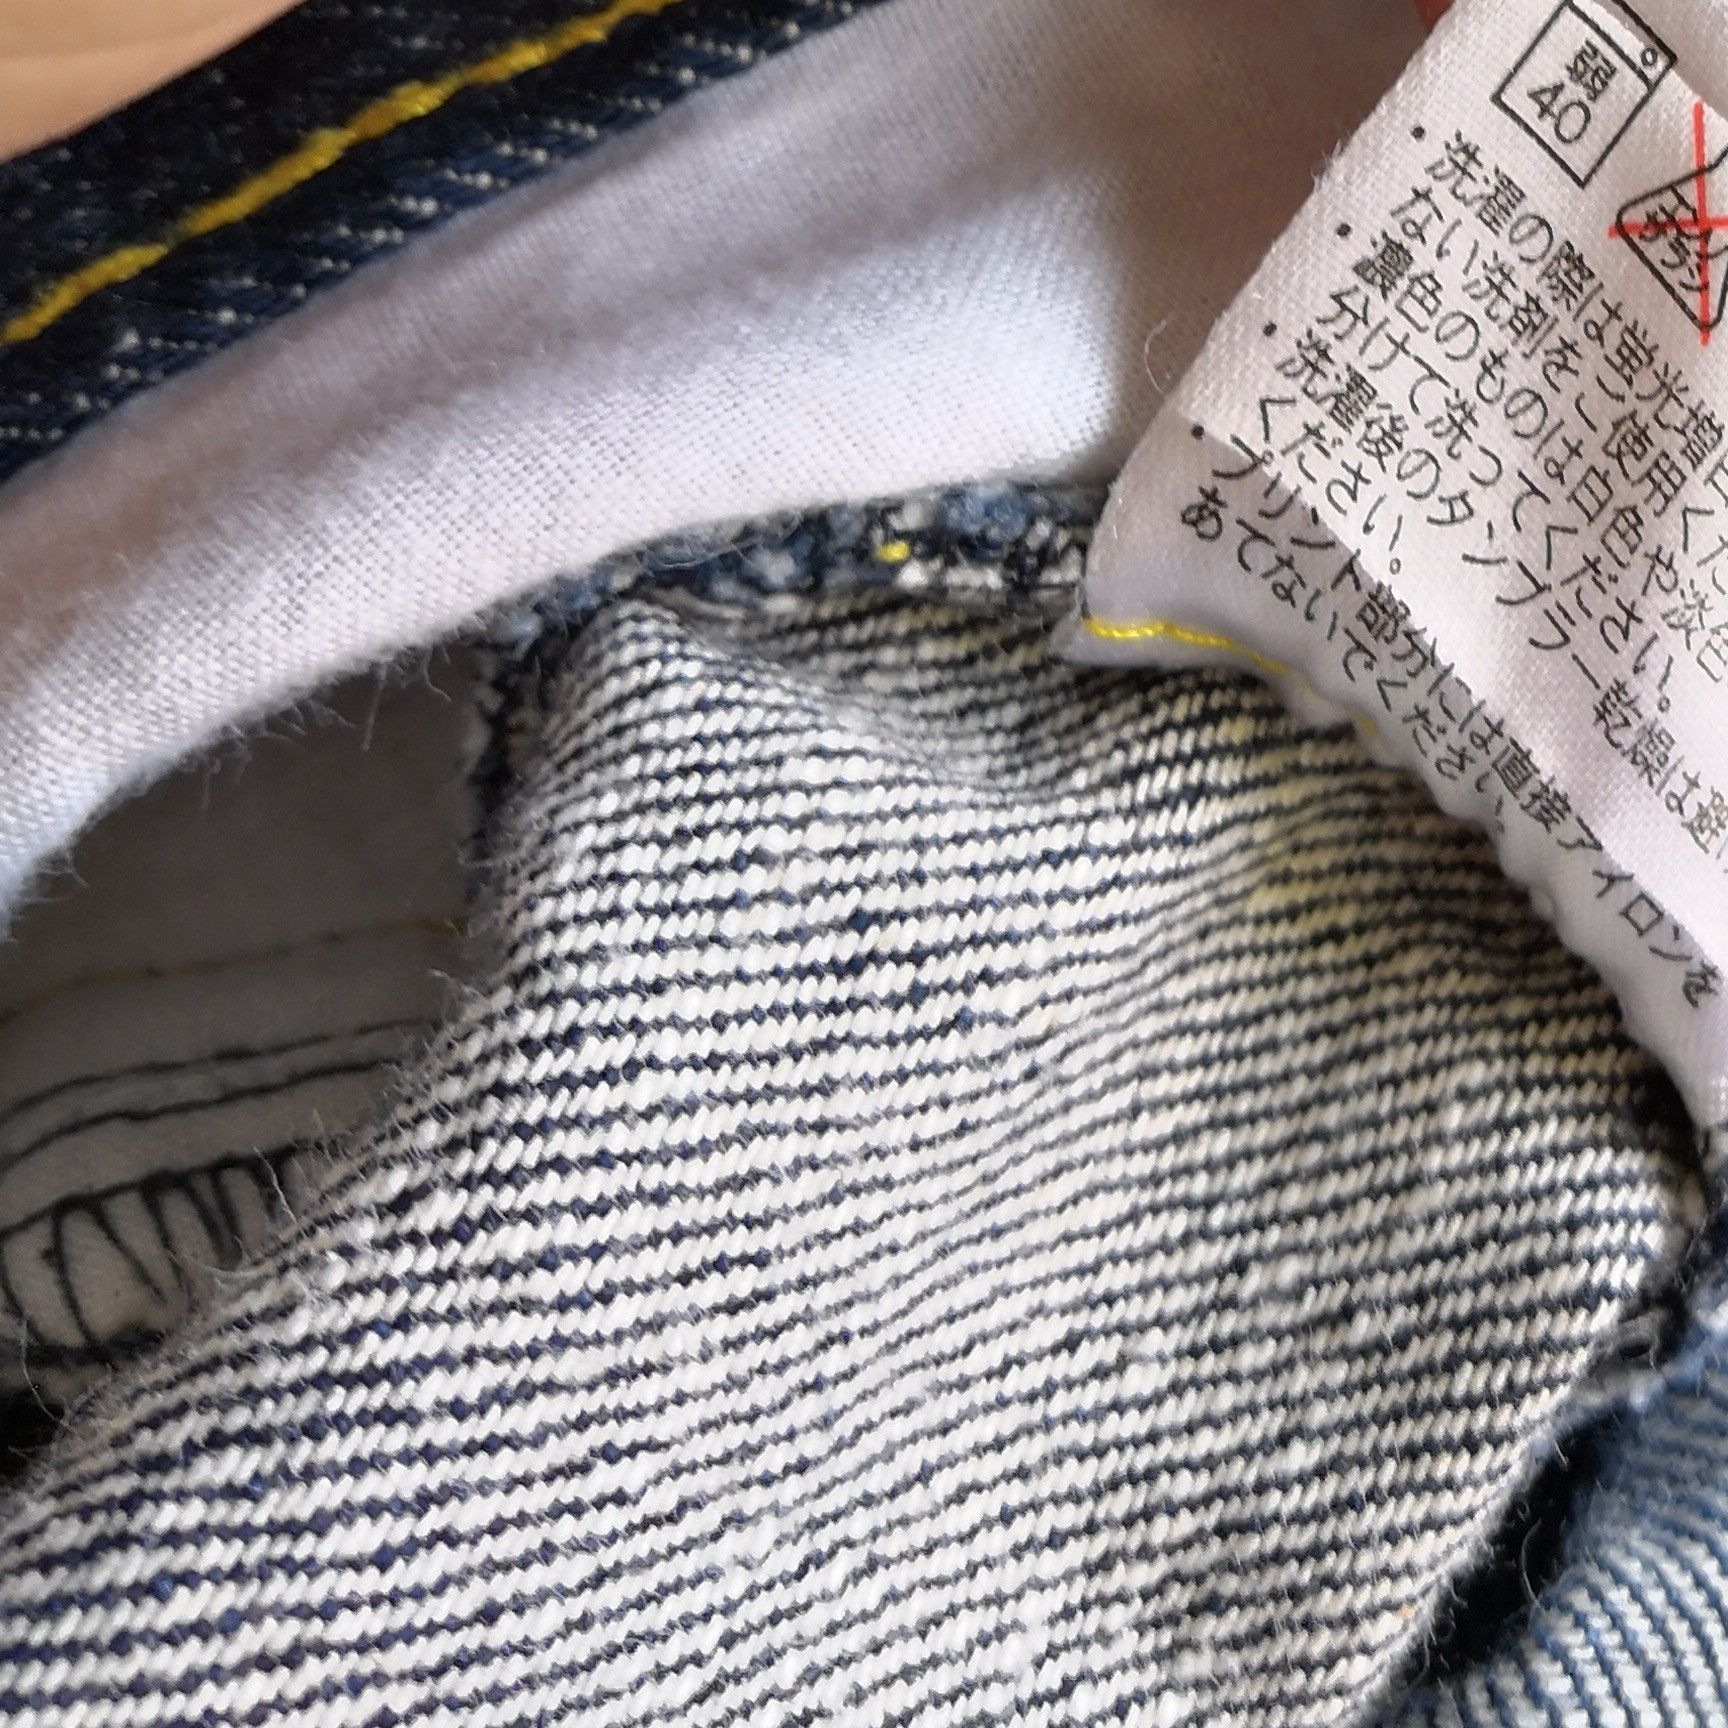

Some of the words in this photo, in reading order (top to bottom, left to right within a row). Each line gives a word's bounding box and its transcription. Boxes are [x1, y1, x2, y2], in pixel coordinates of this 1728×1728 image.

[1564, 37, 1618, 104] 弱
[1528, 81, 1590, 147] 40
[1261, 396, 1403, 575] ください。
